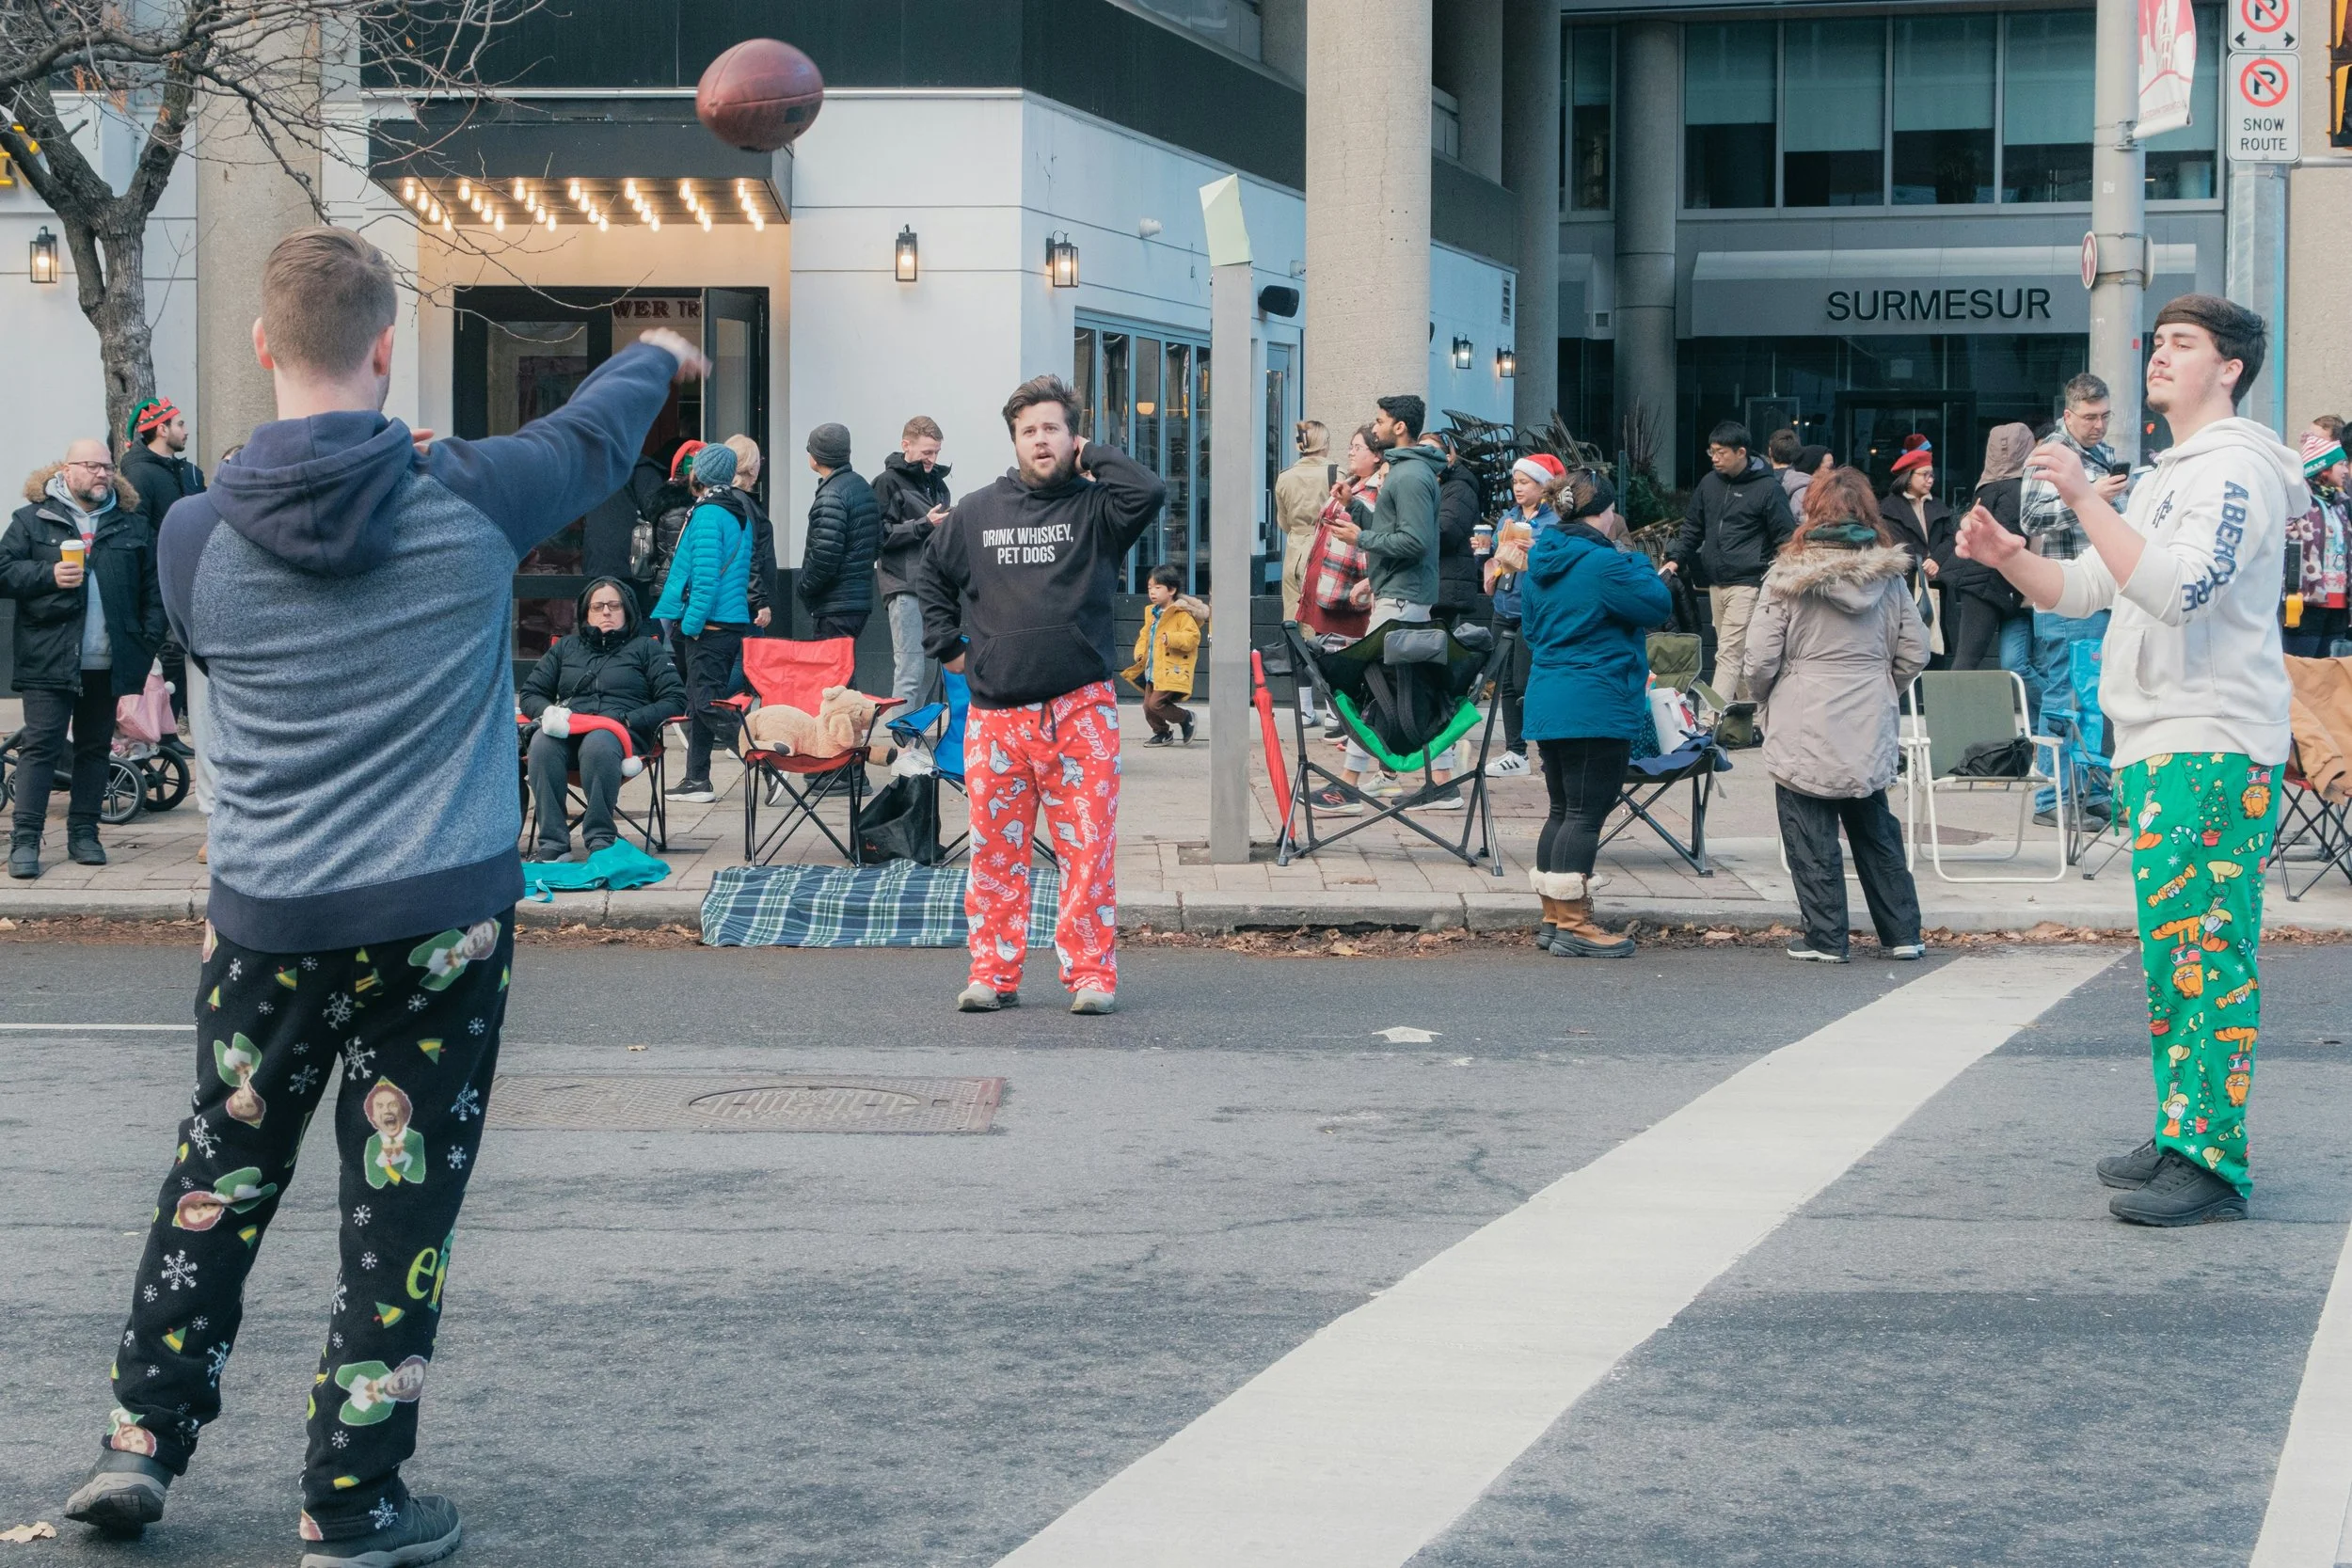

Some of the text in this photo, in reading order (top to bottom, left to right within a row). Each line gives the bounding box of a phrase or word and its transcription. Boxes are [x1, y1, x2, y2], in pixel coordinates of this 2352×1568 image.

[2243, 118, 2284, 132] SNOW
[2240, 137, 2287, 151] ROUTE
[677, 300, 702, 318] TR
[1826, 288, 2052, 321] SURMESUR
[982, 523, 1074, 547] DRINK WHISKEY,
[997, 545, 1056, 565] PET DOGS
